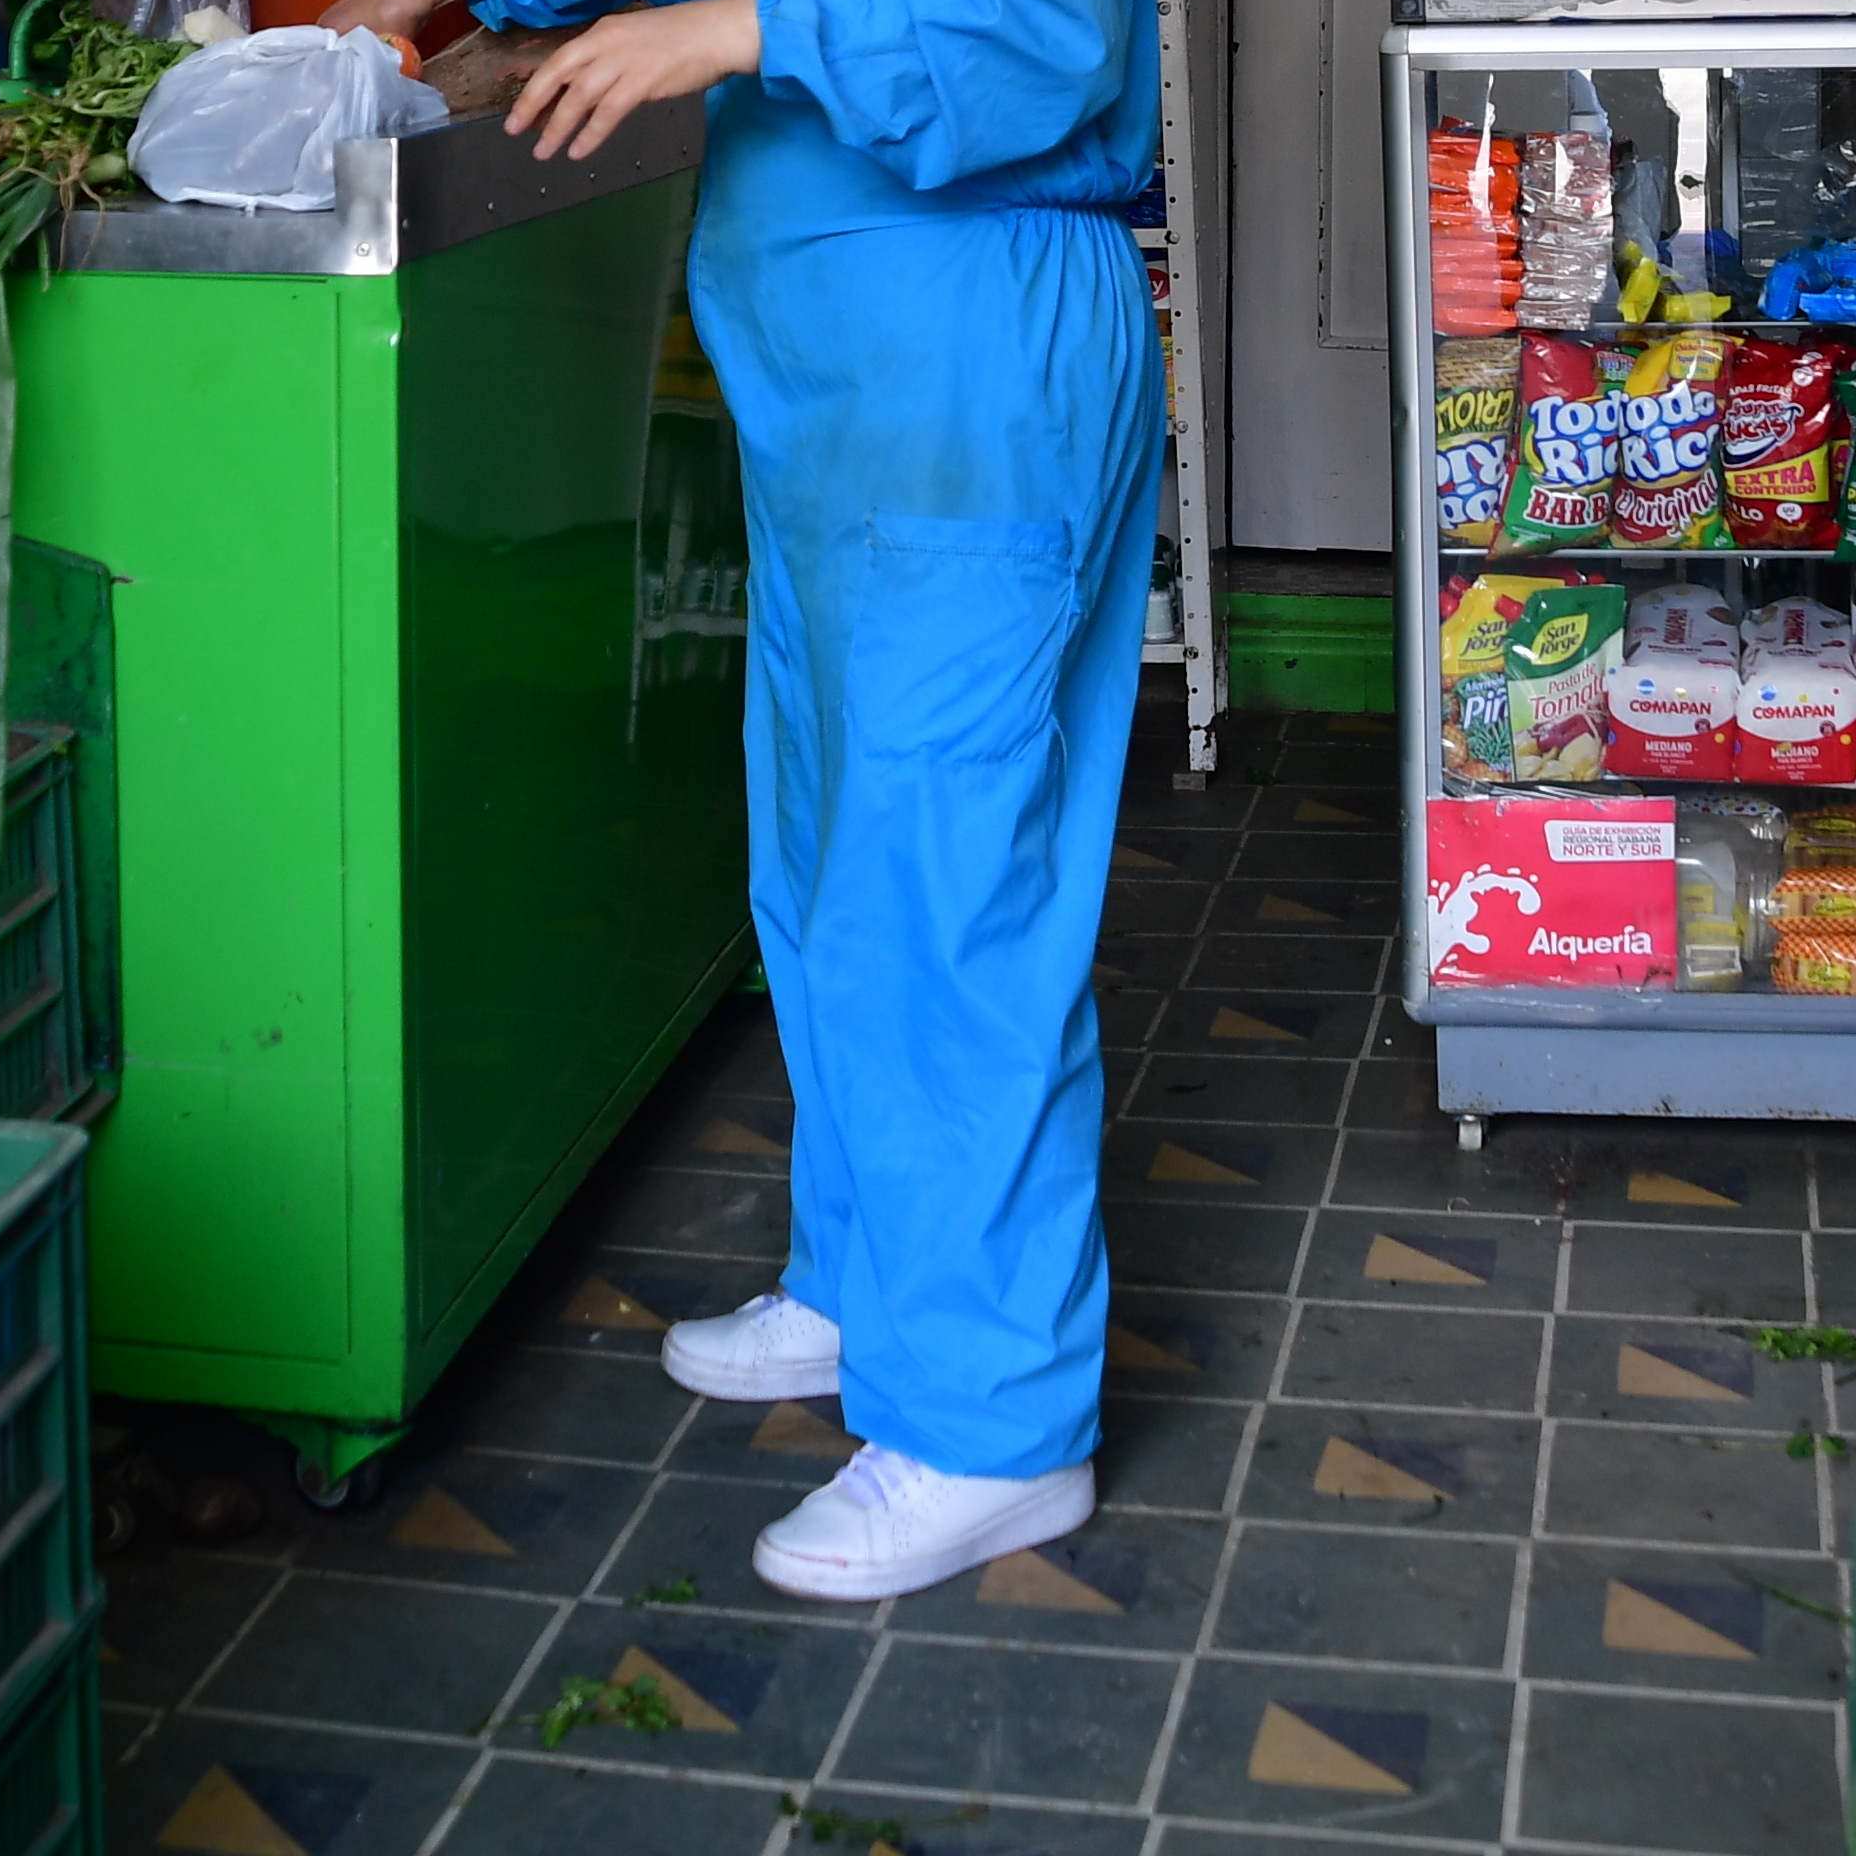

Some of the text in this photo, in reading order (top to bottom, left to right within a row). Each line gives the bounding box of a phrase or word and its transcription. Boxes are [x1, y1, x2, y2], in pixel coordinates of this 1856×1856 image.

[1756, 383, 1792, 397] FRITAS
[1529, 390, 1622, 441] Tod
[1733, 398, 1786, 416] SUPER
[1734, 459, 1816, 486] EXTRA
[1734, 482, 1817, 496] CONTENIDO
[1526, 487, 1588, 526] BAR
[1546, 621, 1577, 642] San
[1540, 633, 1581, 656] Jorge
[1548, 661, 1597, 694] Pasta de
[1629, 698, 1713, 716] COMAPAN
[1752, 704, 1836, 720] COMAPAN
[1645, 740, 1693, 753] MEDIANO
[1562, 825, 1661, 836] GUÍA DE EXHIBICIÓN
[1562, 835, 1662, 844] REGIONAL SABANA
[1562, 844, 1662, 857] NORTE Y SUR
[1527, 925, 1652, 965] Alquería
